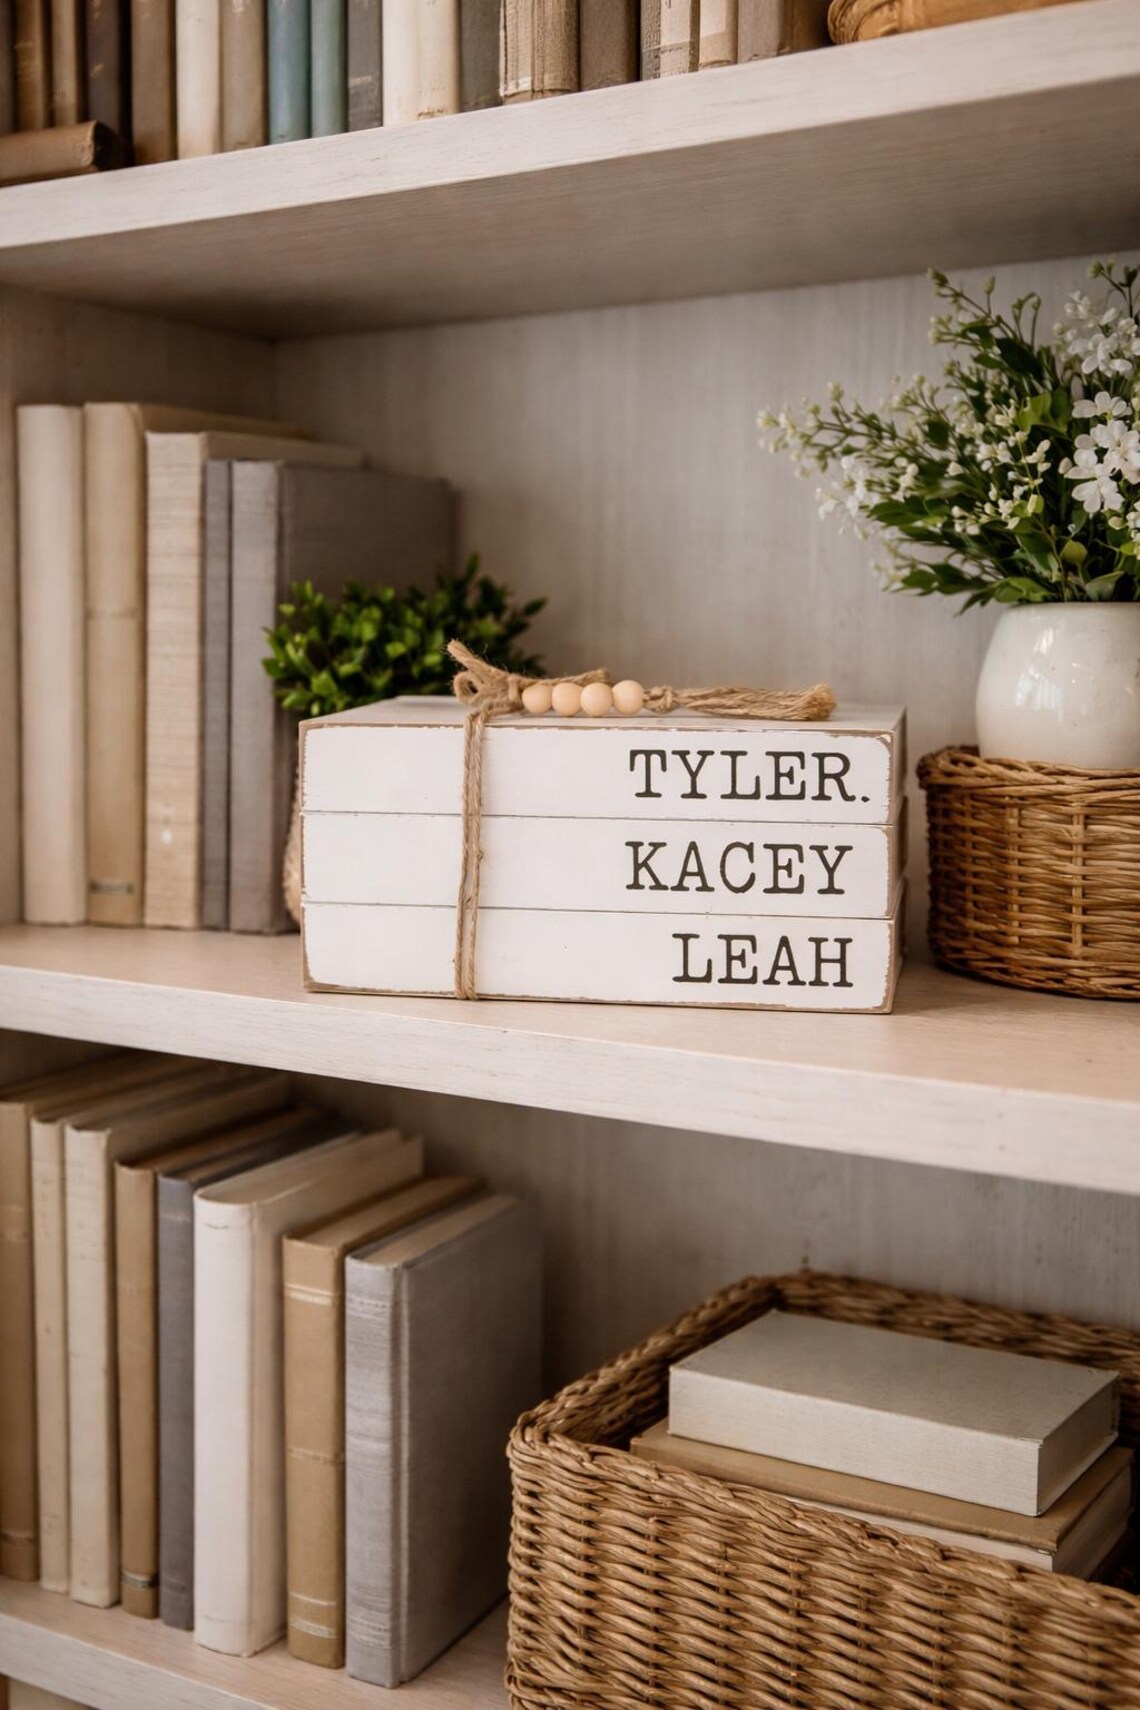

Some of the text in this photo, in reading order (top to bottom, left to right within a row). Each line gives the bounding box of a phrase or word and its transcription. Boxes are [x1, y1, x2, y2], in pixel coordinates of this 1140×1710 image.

[629, 749, 870, 802] TYLER.
[625, 840, 853, 894] KACEY
[672, 933, 853, 987] LEAH
